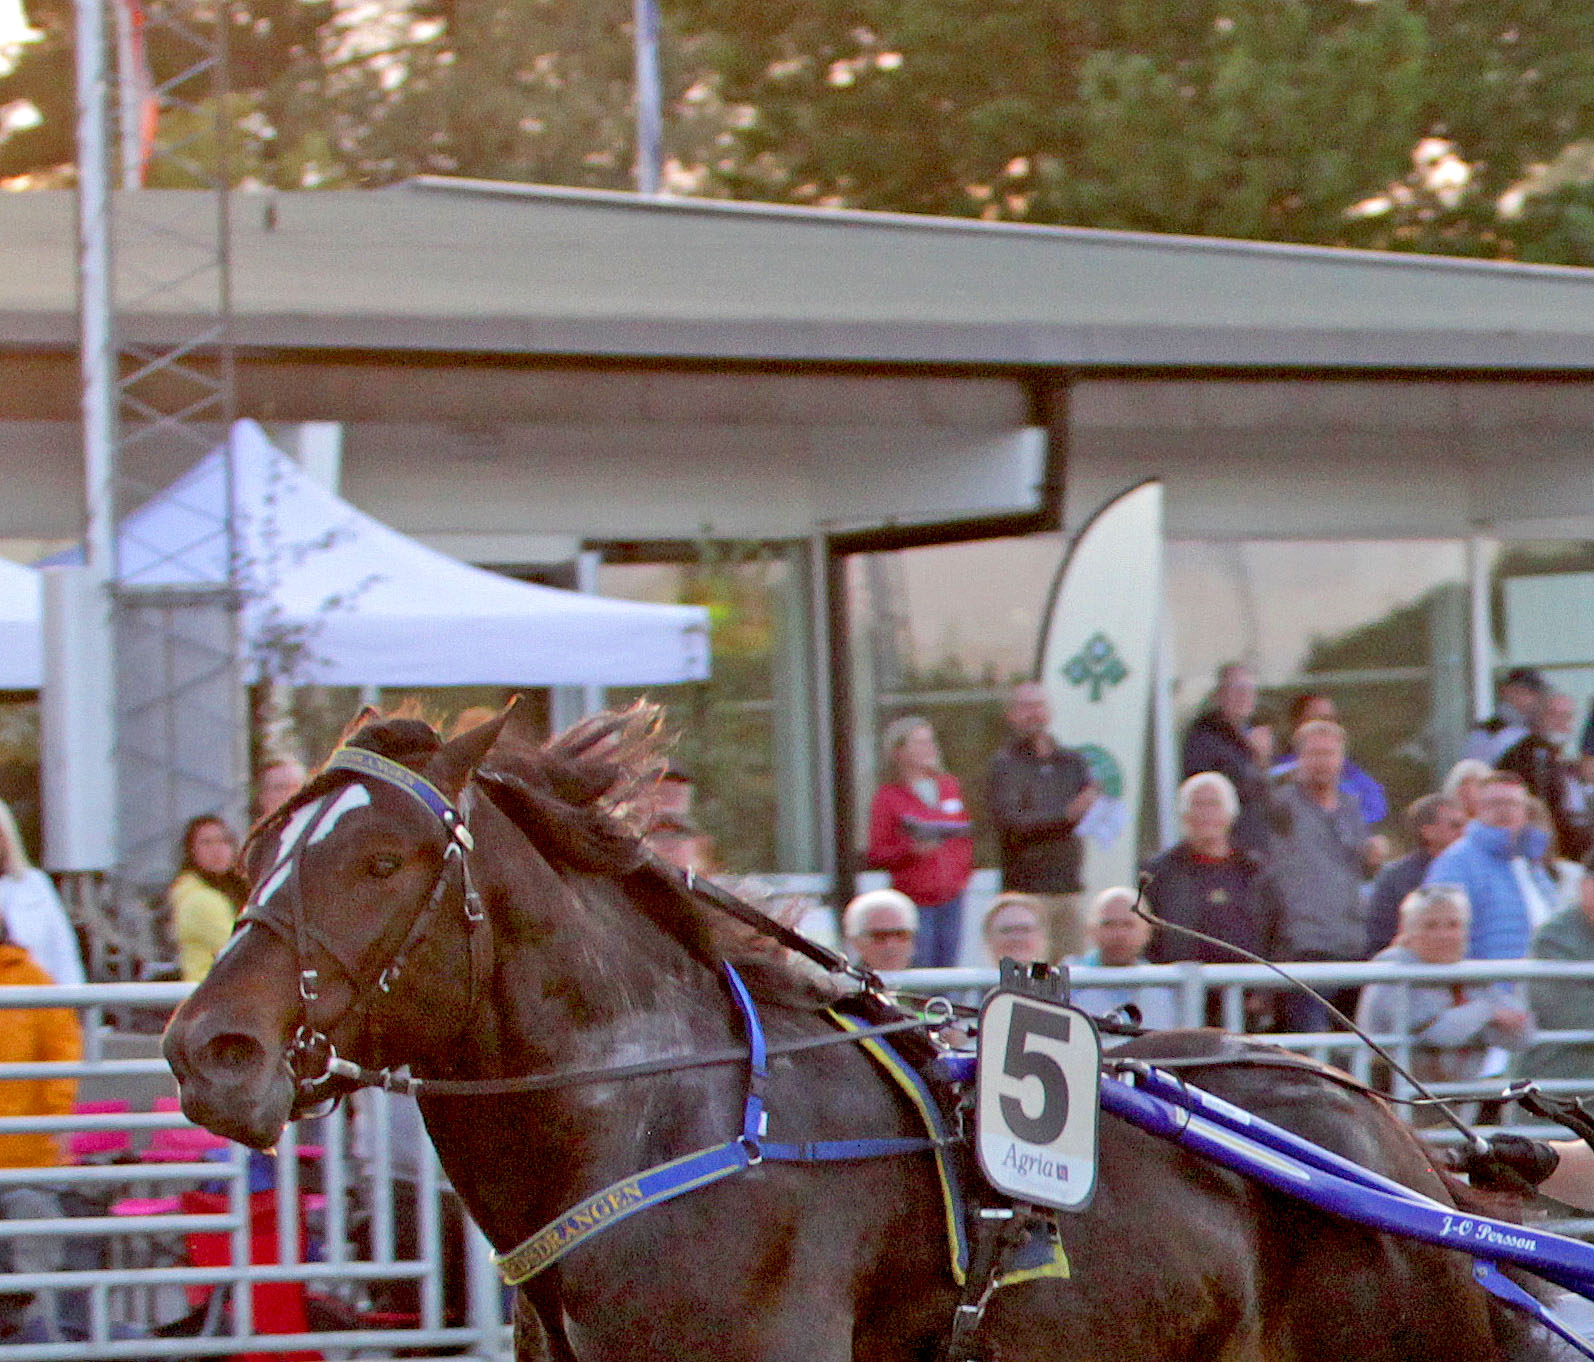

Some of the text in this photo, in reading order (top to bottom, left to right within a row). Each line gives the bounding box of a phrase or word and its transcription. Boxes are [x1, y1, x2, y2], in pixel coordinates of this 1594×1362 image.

[998, 1002, 1071, 1145] 5
[1002, 1142, 1054, 1175] Agria
[1439, 1215, 1537, 1252] J-O Persson
